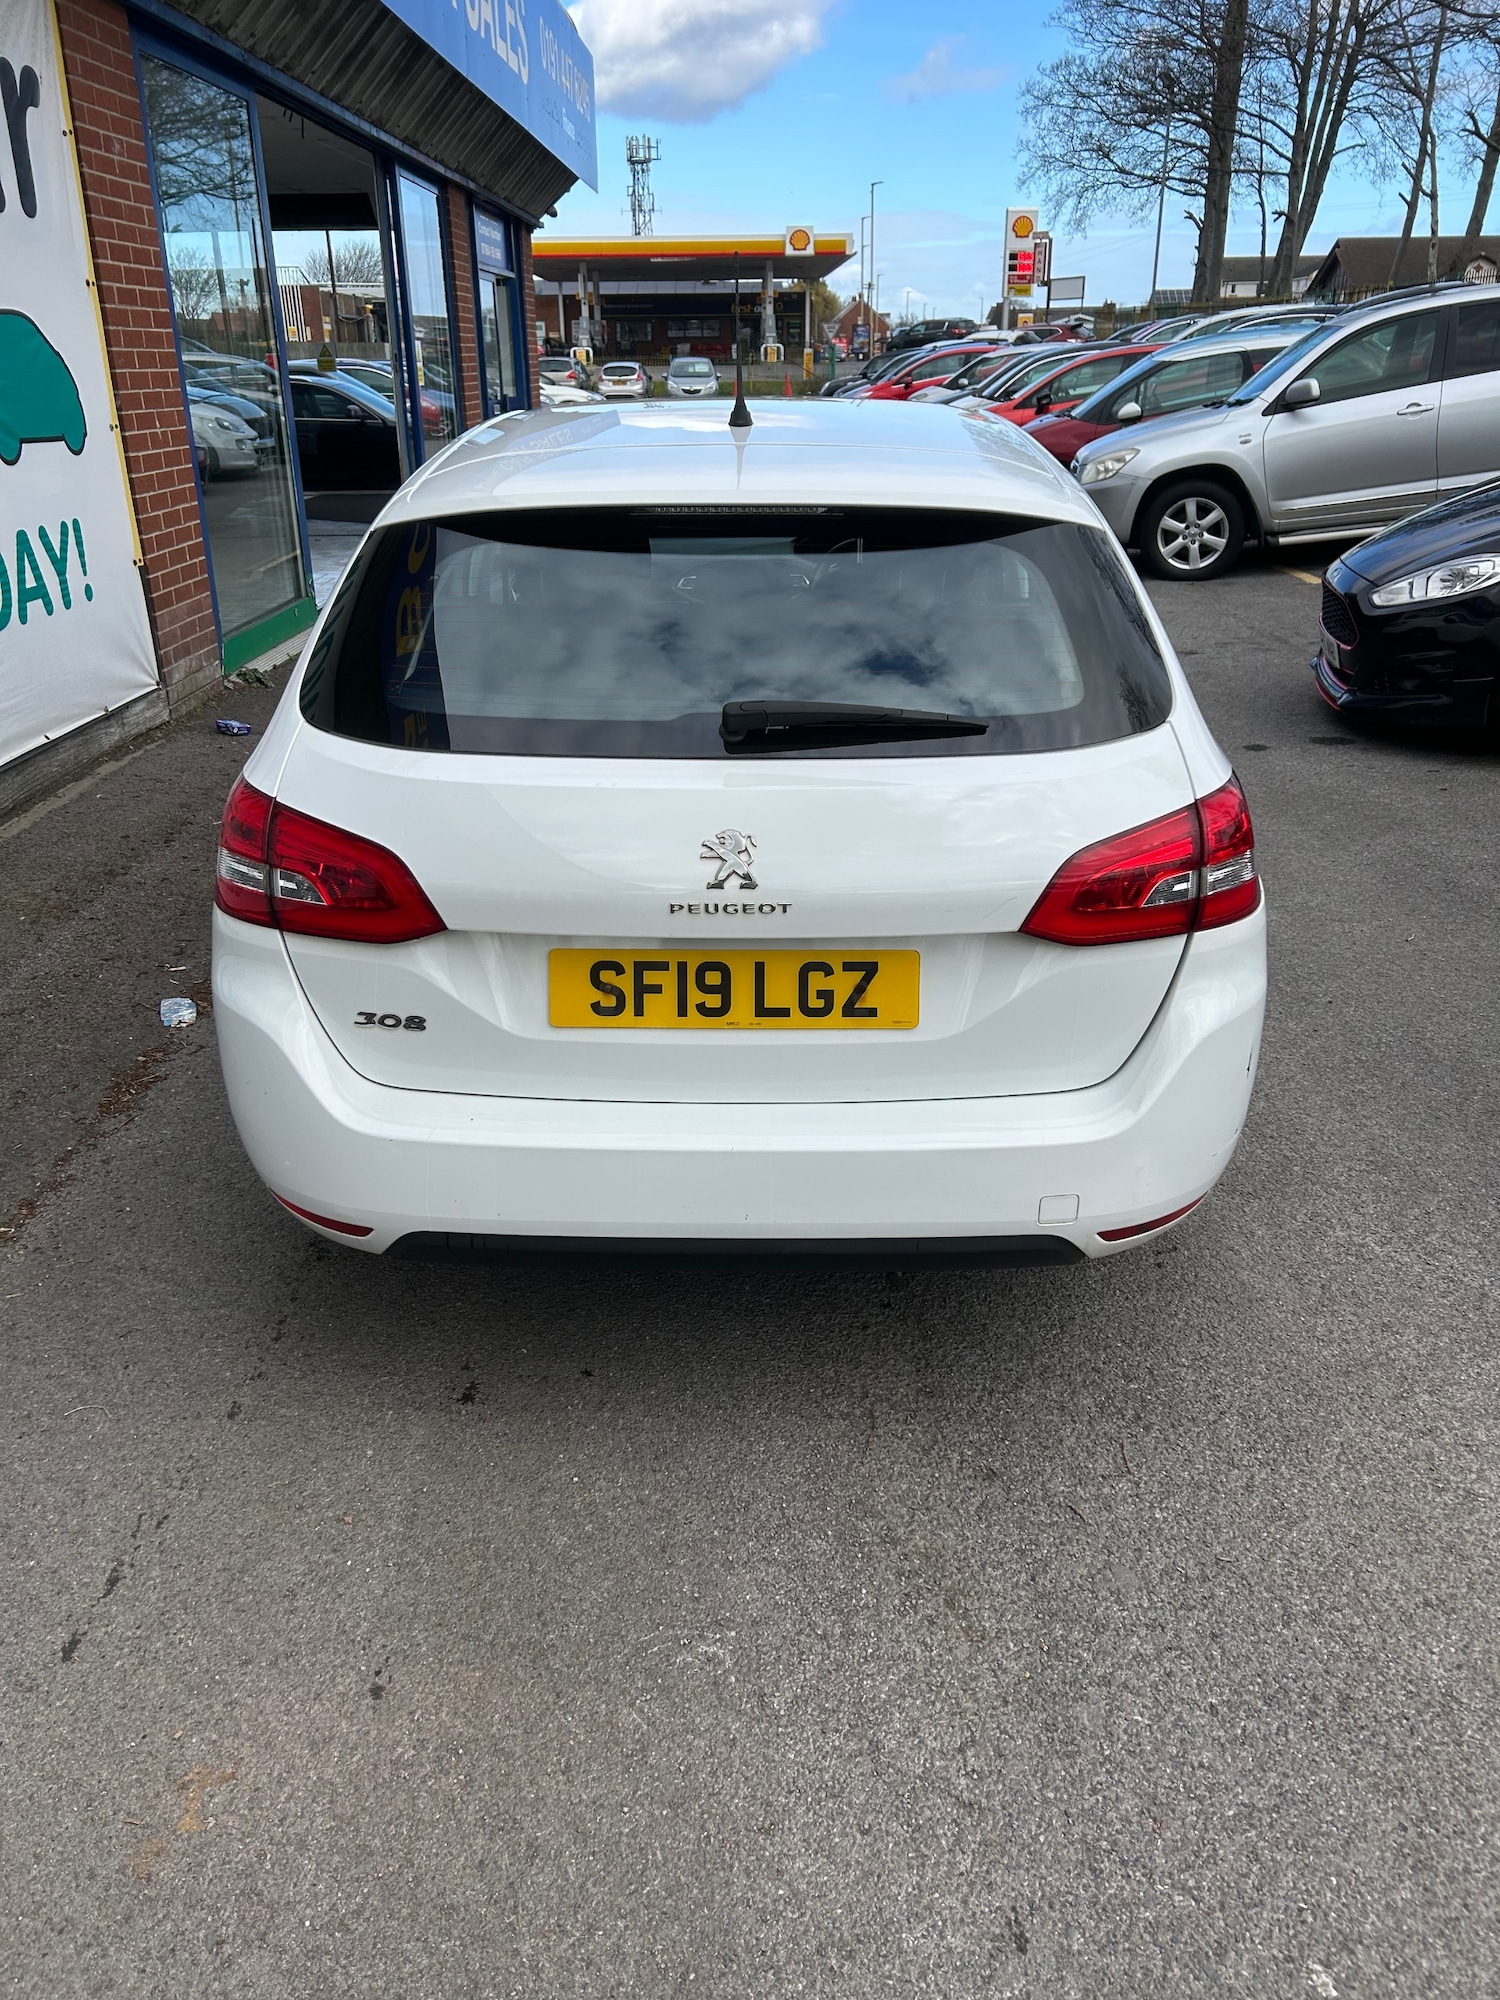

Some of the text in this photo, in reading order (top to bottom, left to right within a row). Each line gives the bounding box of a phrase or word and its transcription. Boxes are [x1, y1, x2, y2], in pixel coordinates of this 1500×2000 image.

[539, 15, 560, 86] 0191
[561, 48, 573, 102] 447
[669, 902, 792, 914] PEUGEOT
[589, 960, 879, 1018] SF19 LGZ
[354, 1011, 427, 1032] 308
